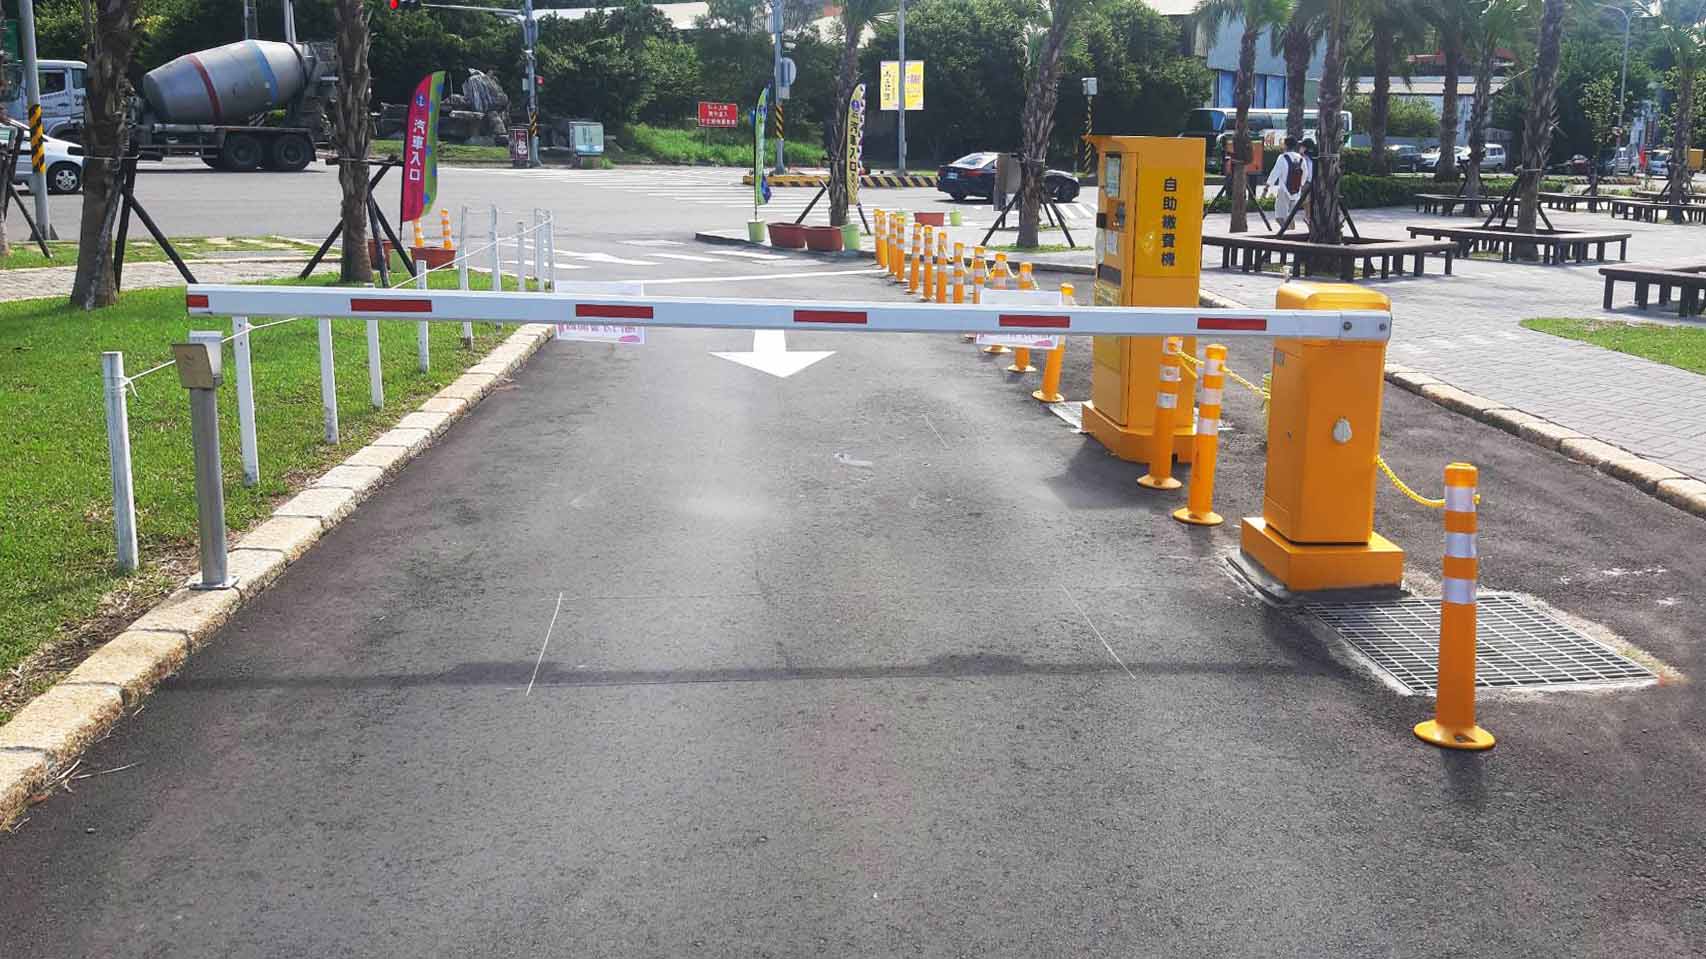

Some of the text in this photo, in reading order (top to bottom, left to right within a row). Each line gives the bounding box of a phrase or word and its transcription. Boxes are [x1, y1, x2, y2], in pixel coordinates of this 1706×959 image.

[409, 119, 426, 181] 汽車入口
[1161, 176, 1177, 267] 自助繳費機
